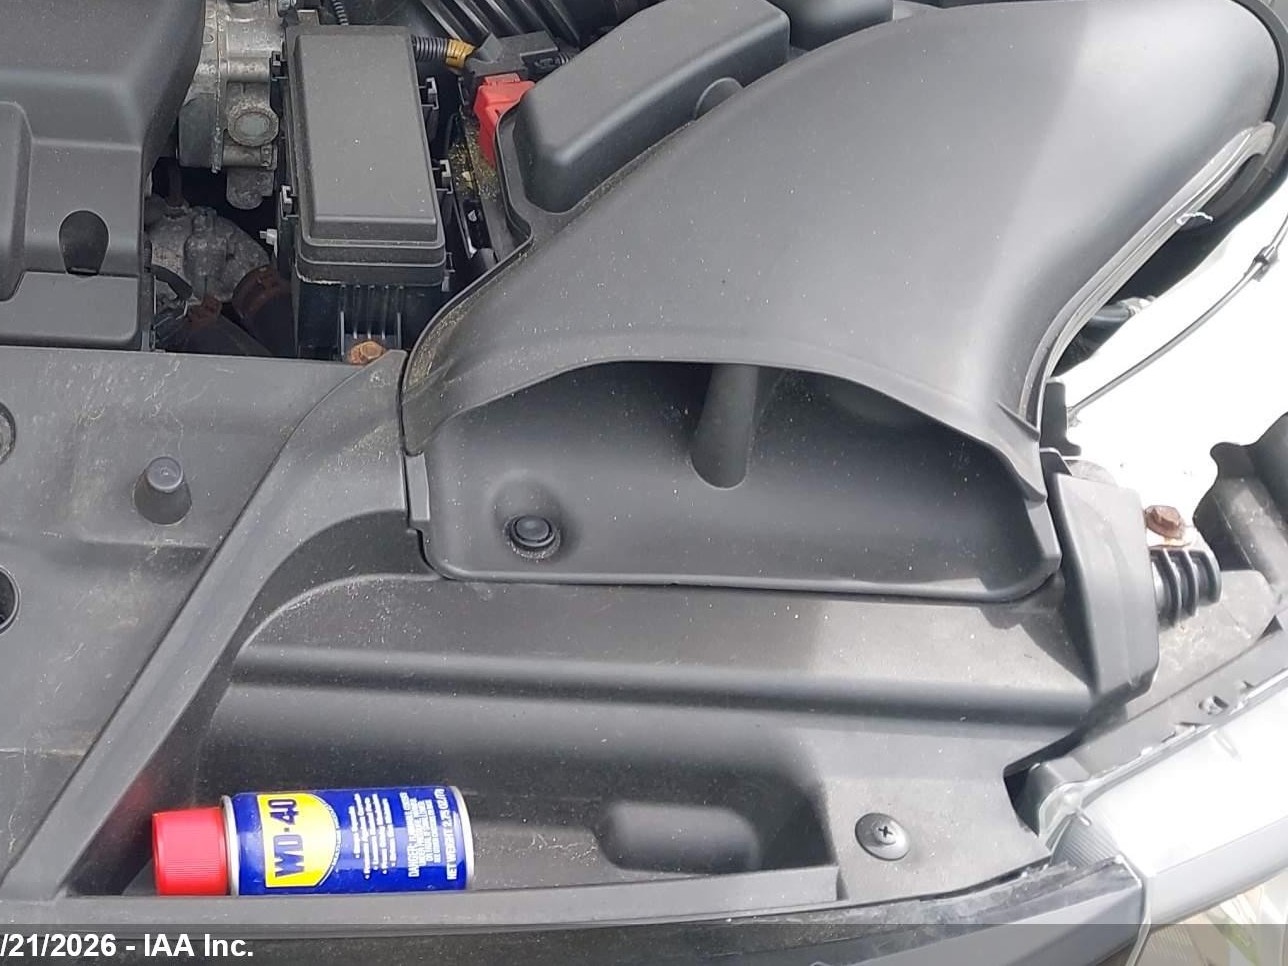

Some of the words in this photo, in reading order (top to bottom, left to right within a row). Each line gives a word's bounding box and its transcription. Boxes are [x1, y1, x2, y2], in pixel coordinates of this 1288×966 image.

[267, 799, 306, 878] WD-40
[443, 828, 456, 863] WEIGHT
[446, 863, 457, 880] NET
